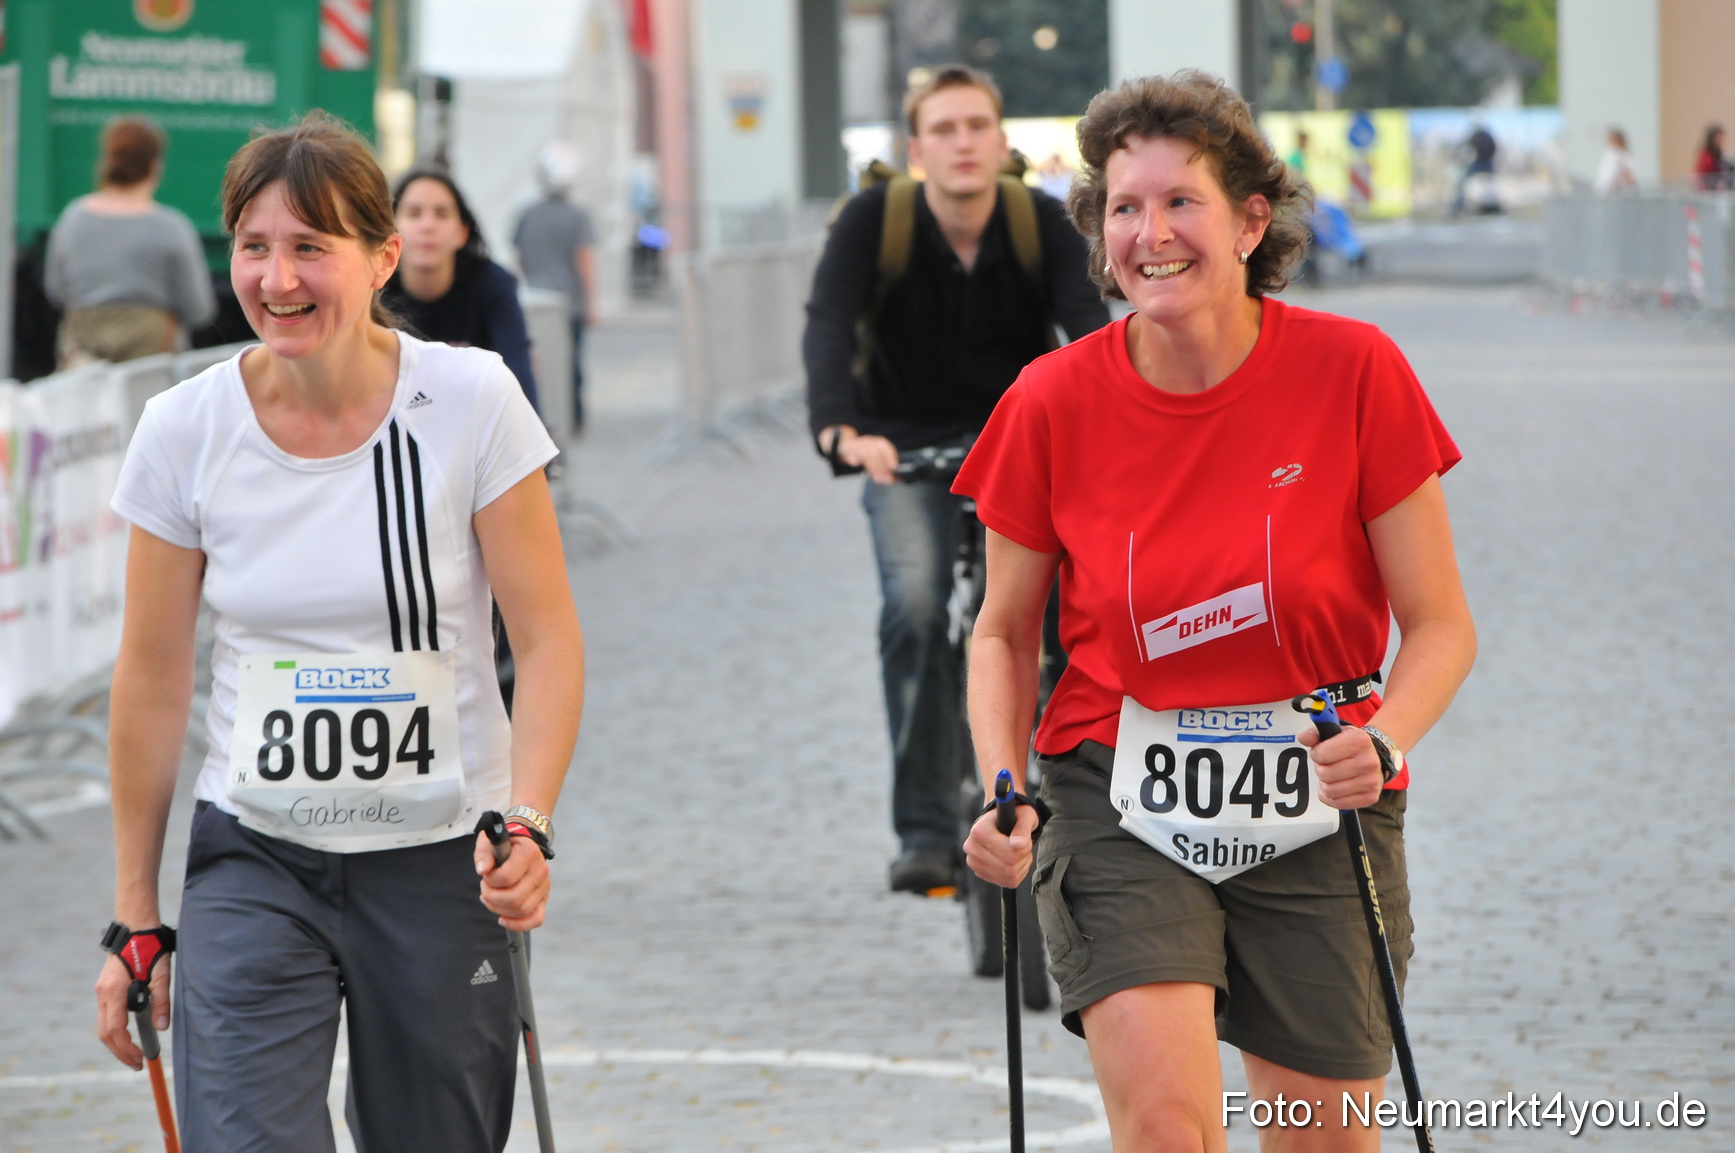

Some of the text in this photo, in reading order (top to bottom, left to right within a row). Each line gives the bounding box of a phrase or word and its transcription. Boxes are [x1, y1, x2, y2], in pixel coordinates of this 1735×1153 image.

[1179, 604, 1232, 640] DEHN
[295, 668, 391, 689] BOCK
[1177, 709, 1274, 731] BOCK
[257, 705, 435, 781] 8094
[1139, 743, 1310, 819] 8049
[289, 796, 405, 827] Gabriele
[1120, 798, 1129, 811] N
[1172, 833, 1276, 868] Sabine
[470, 973, 498, 986] adidas
